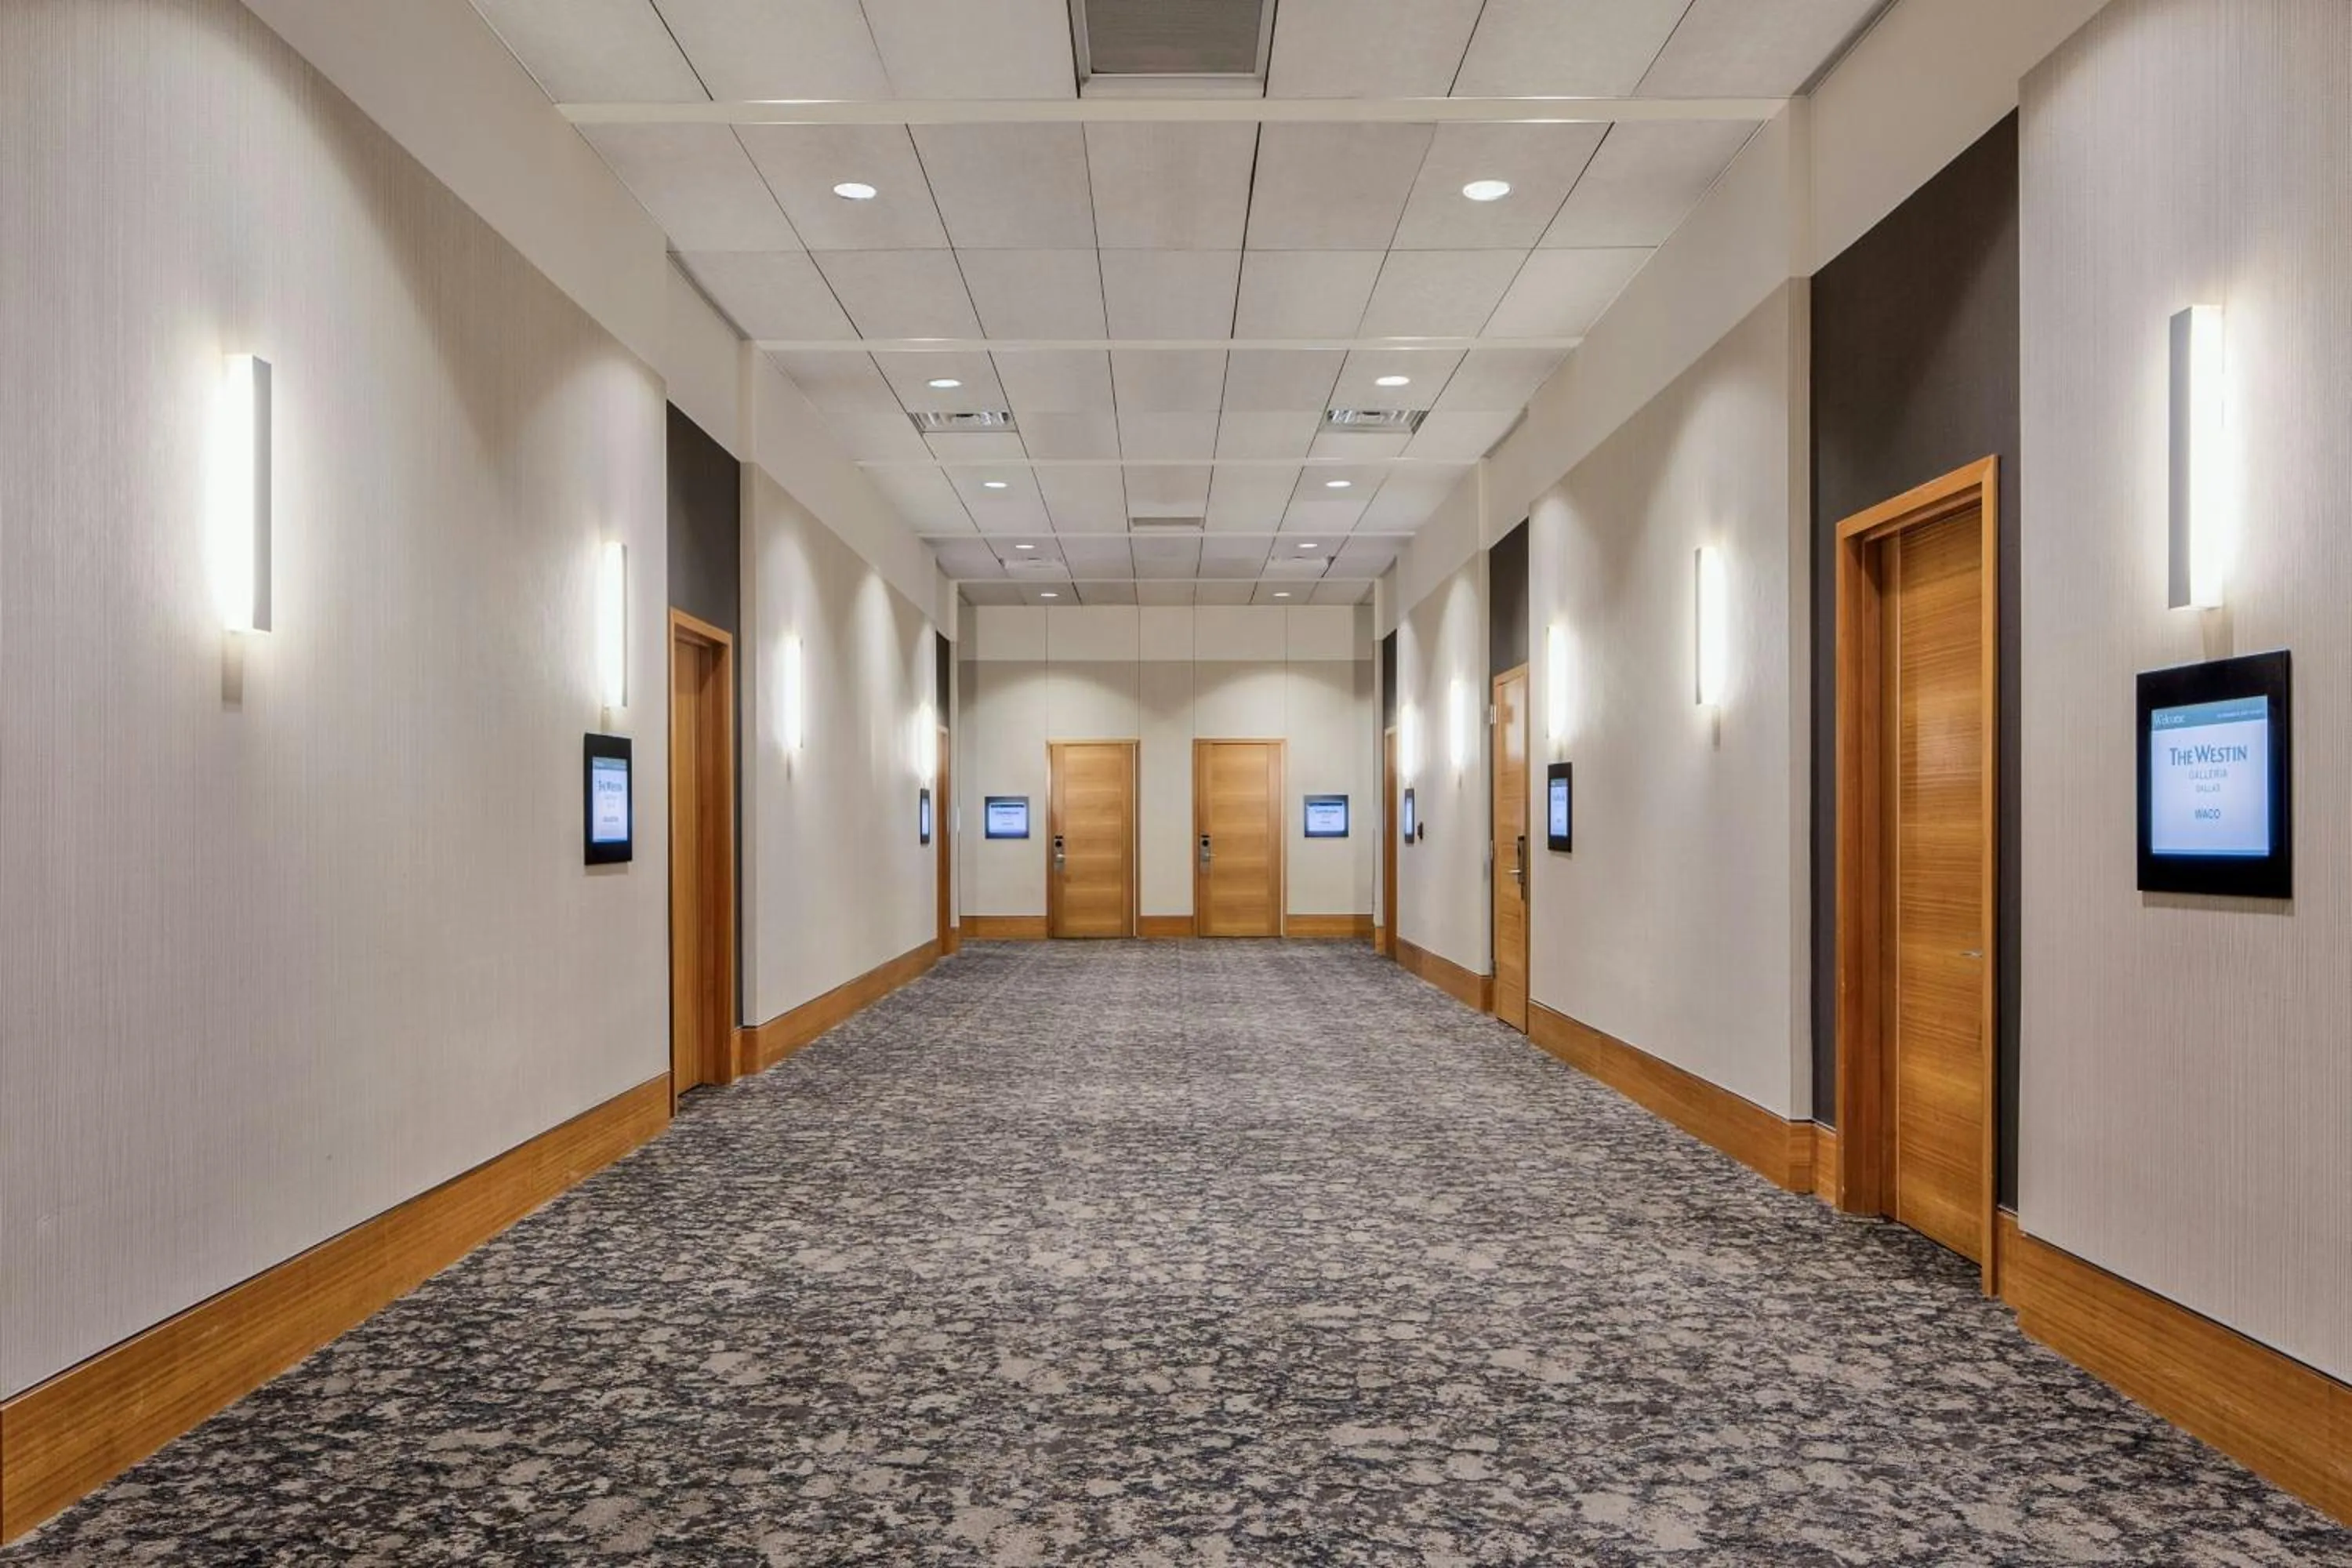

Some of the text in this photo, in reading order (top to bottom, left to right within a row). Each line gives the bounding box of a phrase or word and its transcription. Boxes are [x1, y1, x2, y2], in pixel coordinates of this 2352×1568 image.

[2169, 744, 2248, 766] THE WESTIN
[2194, 808, 2221, 820] WACO
